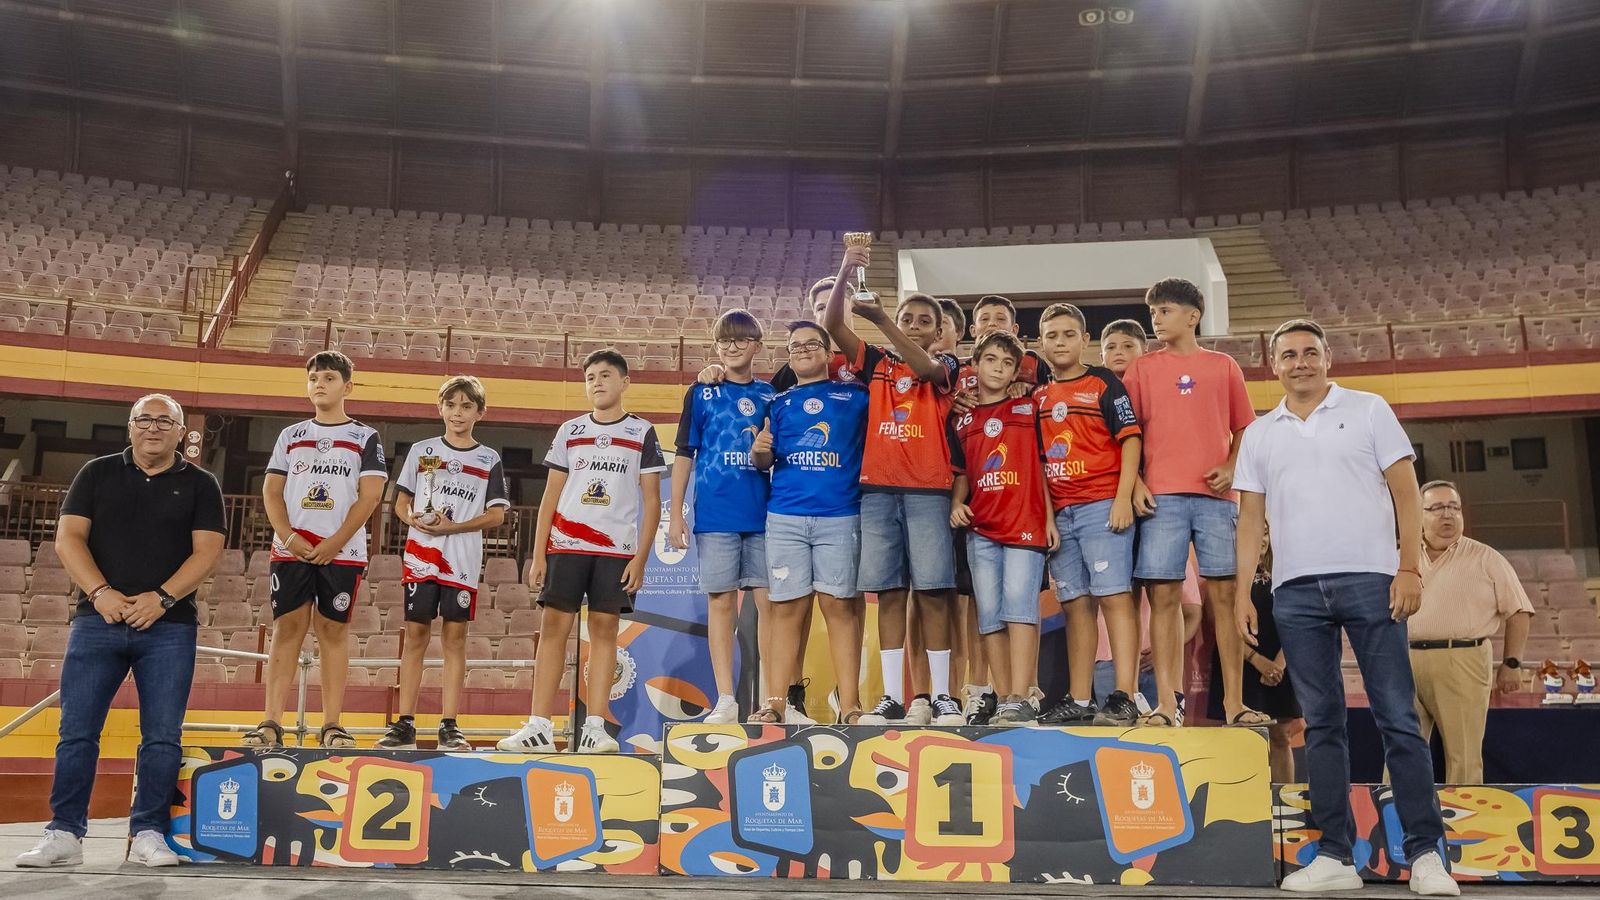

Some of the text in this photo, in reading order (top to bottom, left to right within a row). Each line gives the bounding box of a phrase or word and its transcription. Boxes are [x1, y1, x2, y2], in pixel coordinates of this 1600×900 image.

[960, 375, 978, 389] 13
[702, 385, 721, 401] 81
[570, 424, 586, 436] 22
[592, 455, 630, 464] PINTURAS
[786, 450, 842, 468] FERRESOL
[310, 464, 352, 477] MARIN
[590, 461, 628, 475] MARIN
[443, 480, 479, 493] PINTURAS
[440, 485, 477, 503] MARIN
[676, 575, 688, 583] DE
[933, 763, 984, 836] 1
[362, 778, 411, 841] 2
[1551, 806, 1595, 860] 3
